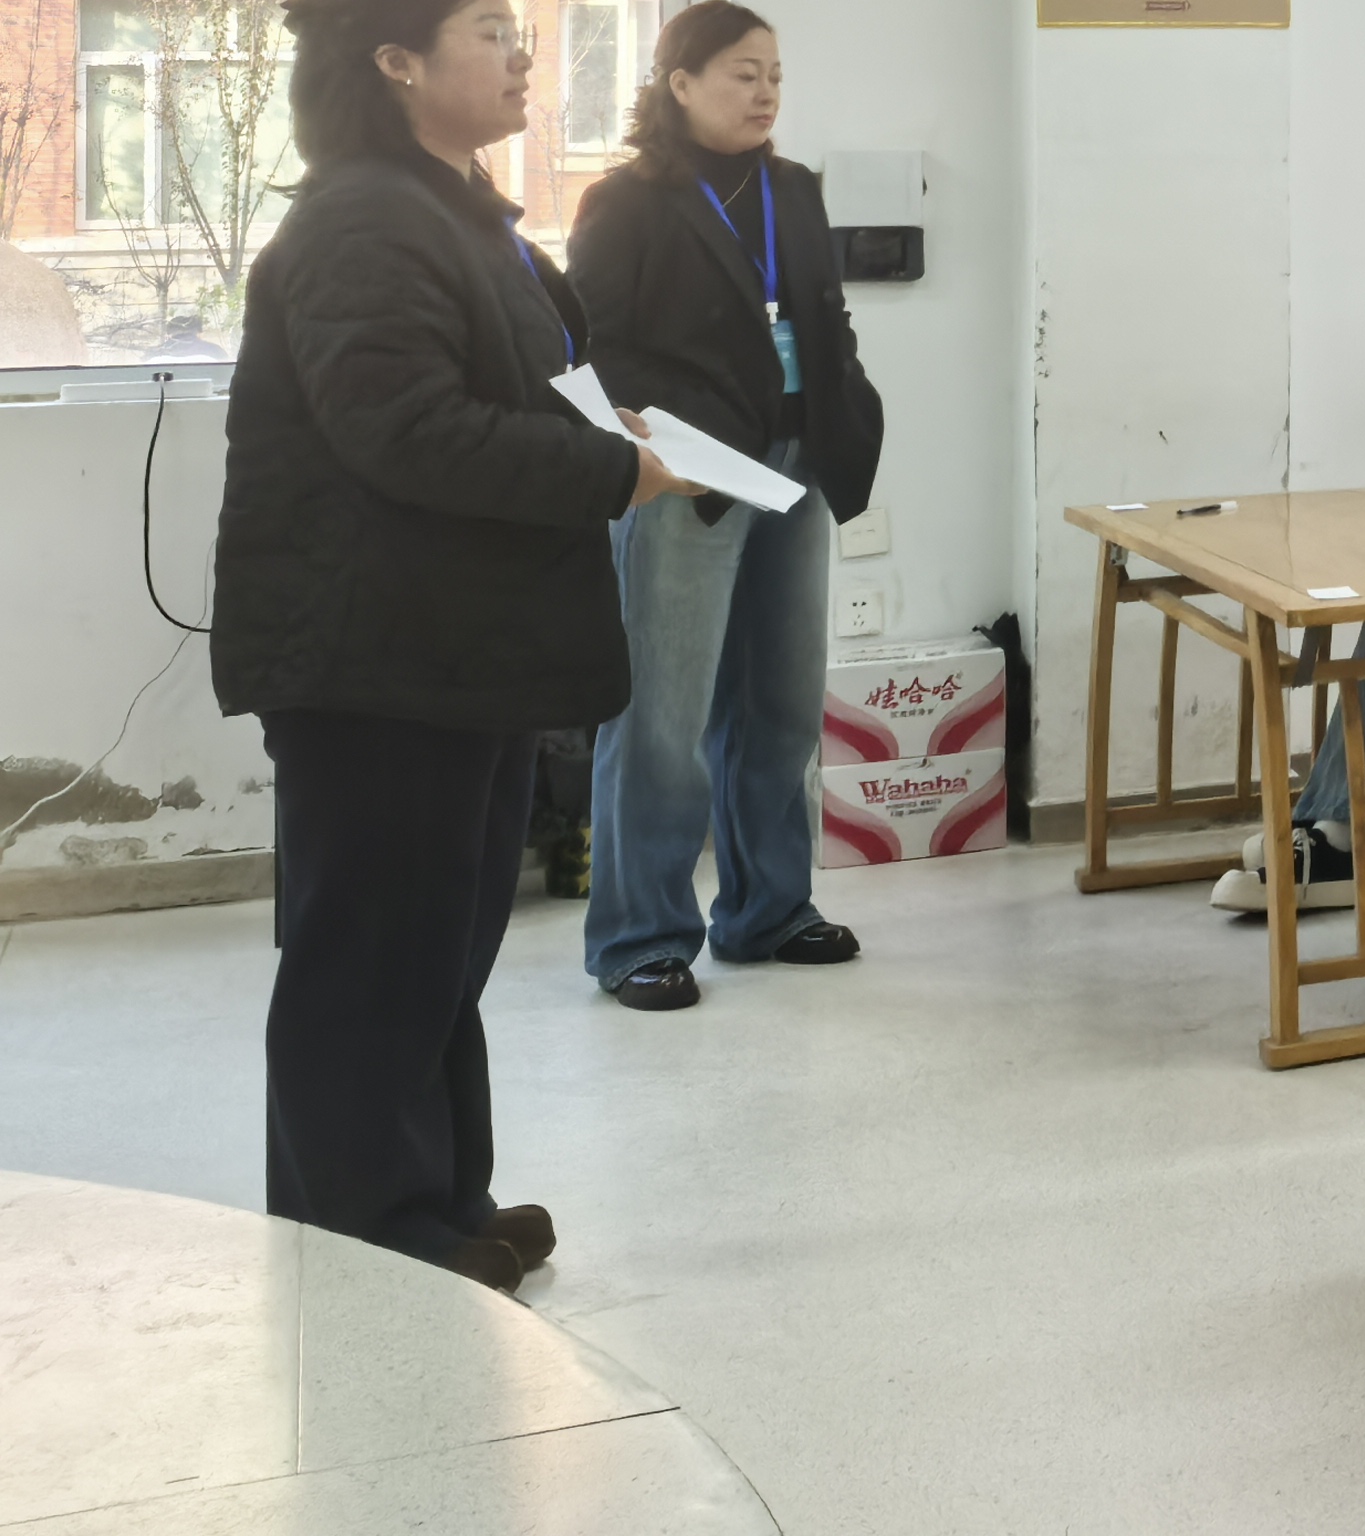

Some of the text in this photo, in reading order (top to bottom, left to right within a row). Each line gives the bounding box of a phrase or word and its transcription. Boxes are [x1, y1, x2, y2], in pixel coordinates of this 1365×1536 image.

[865, 674, 962, 709] 娃哈哈
[859, 775, 968, 804] Wahaha
